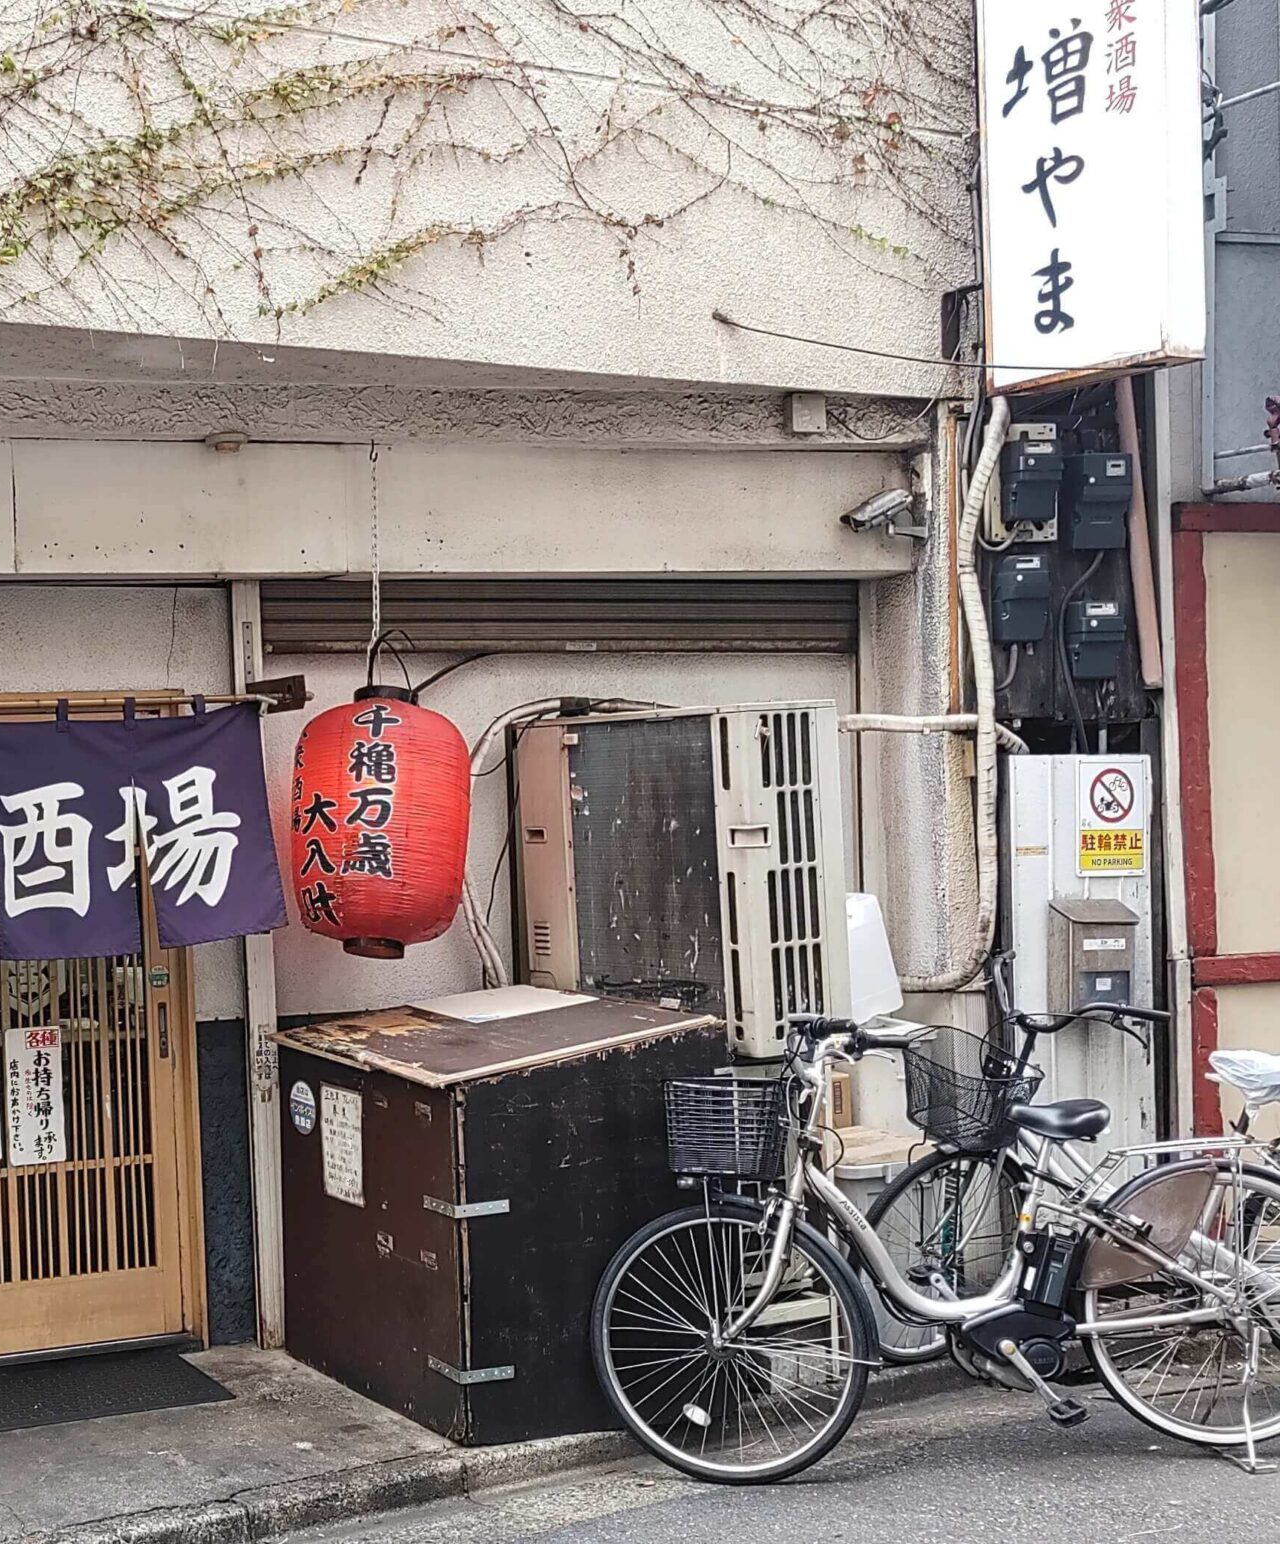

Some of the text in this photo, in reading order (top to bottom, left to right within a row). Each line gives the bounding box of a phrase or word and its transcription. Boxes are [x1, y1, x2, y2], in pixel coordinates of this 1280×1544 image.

[1002, 17, 1094, 335] 増やま
[1080, 833, 1143, 852] 駐輪禁止
[1091, 857, 1133, 866] NO PARKING
[26, 1030, 58, 1048] 各種
[32, 1050, 54, 1131] お持ち帰り
[839, 1200, 868, 1232] Assista
